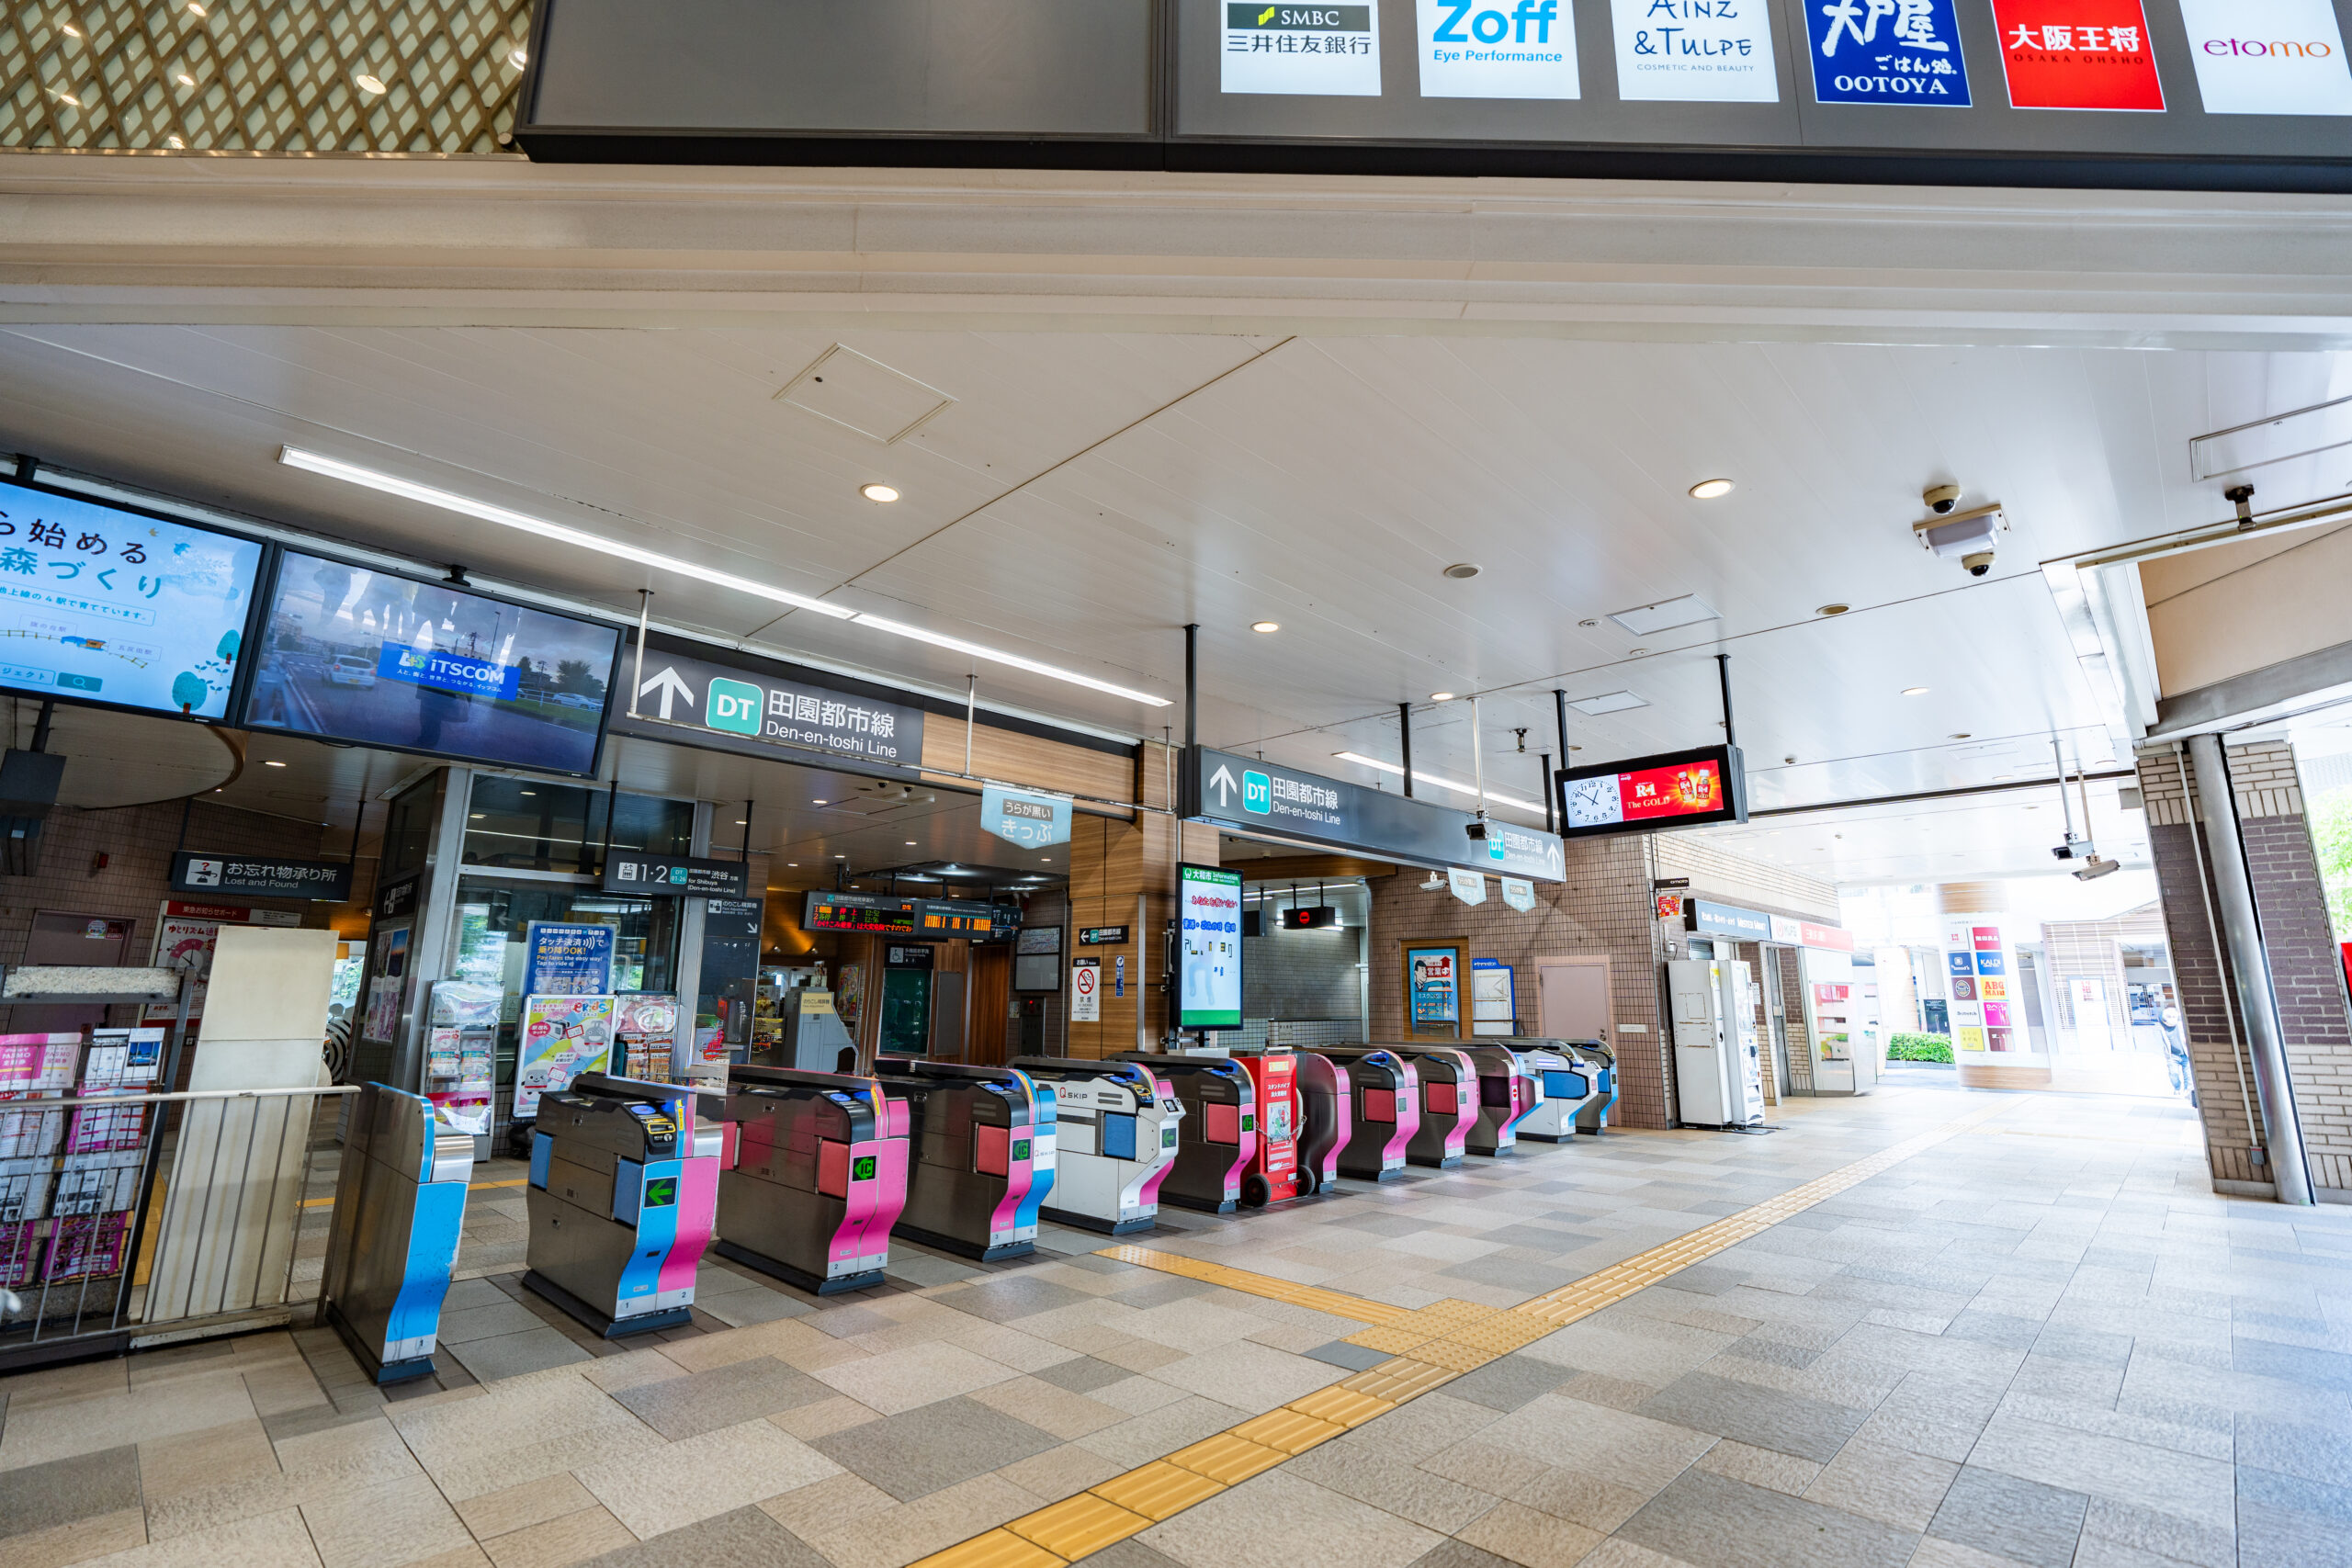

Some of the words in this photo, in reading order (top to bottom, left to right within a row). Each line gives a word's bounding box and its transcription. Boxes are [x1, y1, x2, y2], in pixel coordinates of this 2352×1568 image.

[1281, 9, 1340, 27] SMBC
[1433, 0, 1557, 44] Zoff
[1227, 34, 1371, 55] 三井住友銀行
[2008, 25, 2142, 53] 大阪王将
[2203, 38, 2332, 59] etomo
[1433, 50, 1460, 62] Eye
[1465, 51, 1563, 62] Performance
[2014, 54, 2073, 63] OSAKA
[2084, 55, 2144, 65] OHSHO
[1637, 63, 1688, 72] COSMETIC
[1834, 74, 1950, 95] OOTOYA
[430, 660, 506, 685] iTSCOM
[717, 694, 755, 720] DT
[768, 689, 895, 739] 田園都市線
[766, 720, 865, 754] Den-en-toshi
[867, 739, 898, 759] Line
[1247, 782, 1267, 802] DT
[1272, 776, 1339, 809] 田園都市線
[1627, 801, 1641, 809] The
[1643, 795, 1670, 807] GOLD
[1005, 802, 1051, 818] うらが黒い
[1272, 801, 1323, 823] Den-en-toshi
[1325, 810, 1340, 826] Line
[1001, 818, 1053, 842] きっぷ
[1490, 838, 1502, 852] DT
[1504, 831, 1544, 853] 田園都市線
[226, 862, 337, 883] お忘れ物承り所
[711, 870, 729, 881] 渋谷
[1193, 870, 1213, 881] 大和市
[224, 877, 245, 886] Lost
[248, 878, 266, 887] and
[268, 879, 299, 889] Found
[537, 946, 586, 954] 乗り降りOK!
[539, 937, 581, 946] タッチ決済
[1059, 1087, 1066, 1099] Q
[861, 1162, 872, 1176] IC
